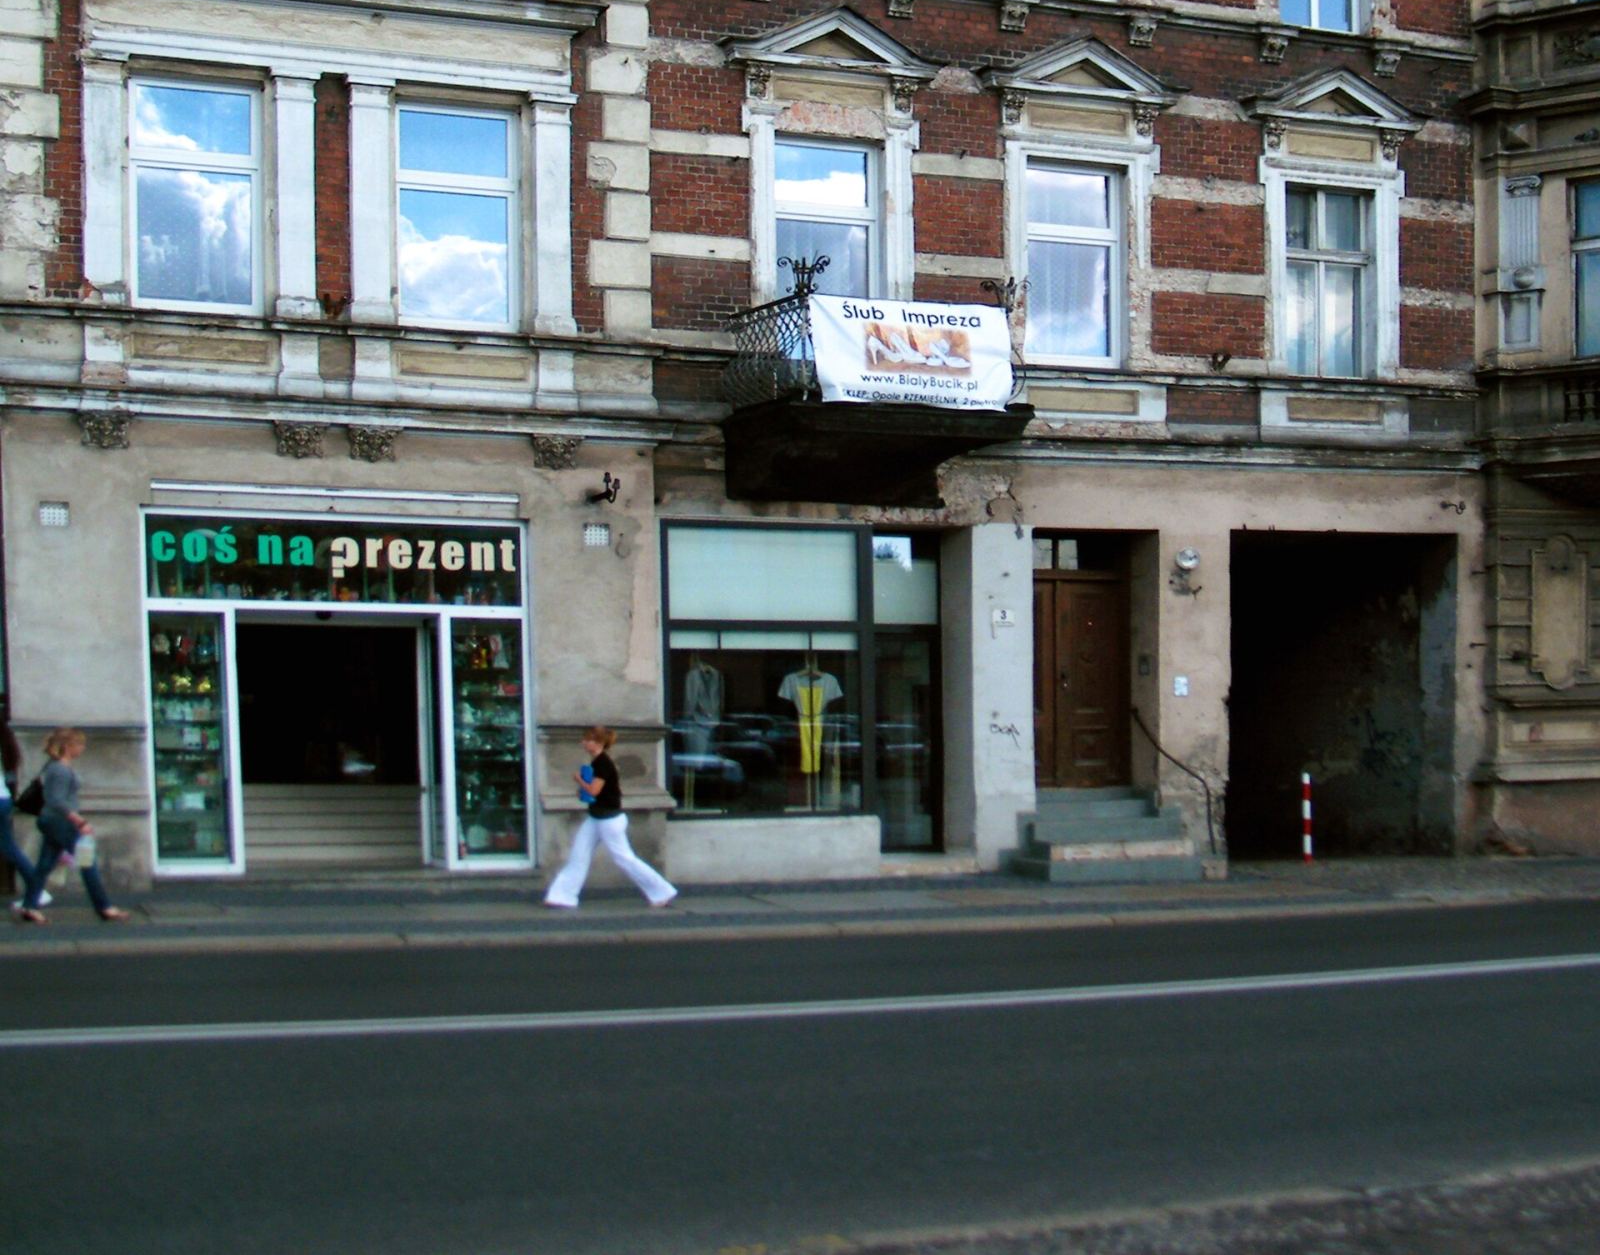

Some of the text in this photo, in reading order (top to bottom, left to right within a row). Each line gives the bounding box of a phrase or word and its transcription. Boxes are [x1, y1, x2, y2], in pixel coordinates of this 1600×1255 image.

[842, 301, 982, 328] Ślub Impreza
[861, 374, 978, 391] www.BialyBucik.pl
[151, 525, 516, 578] coś na prezent
[1000, 609, 1007, 620] 3
